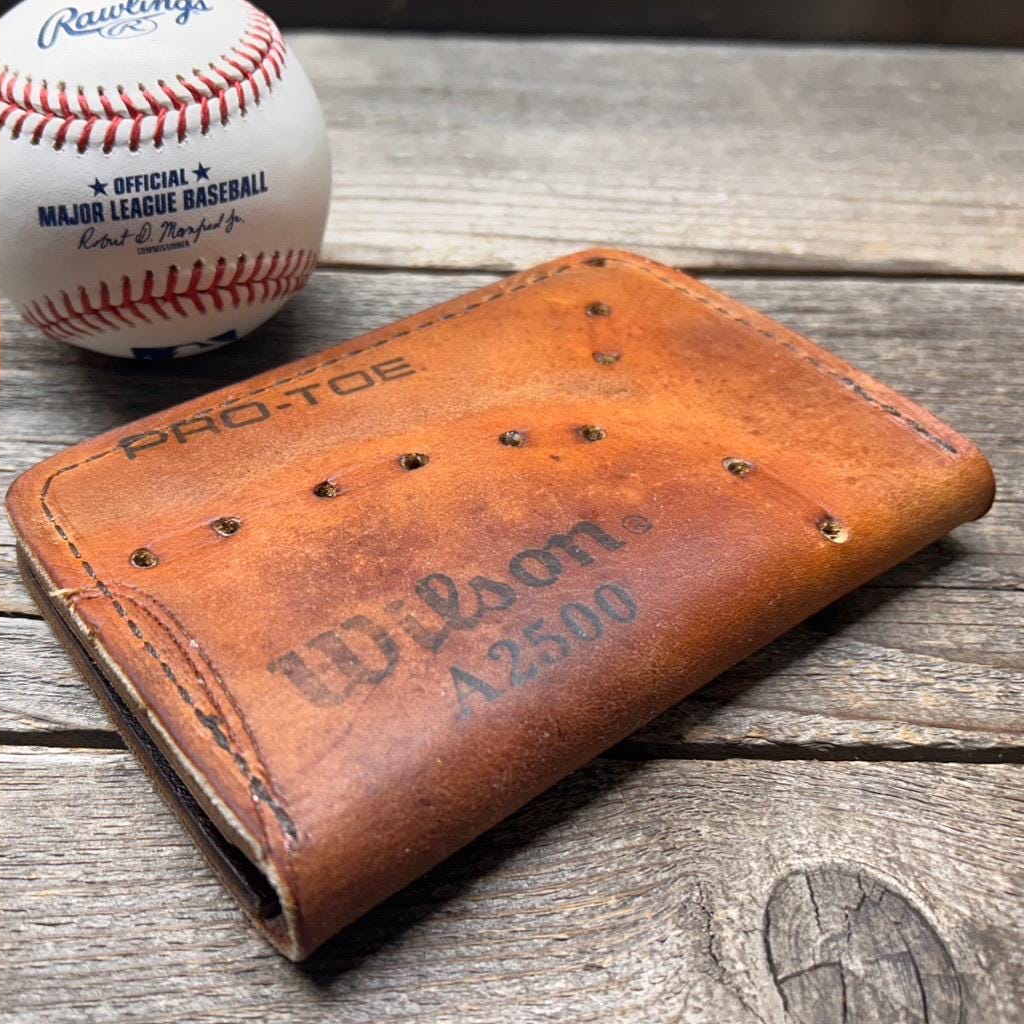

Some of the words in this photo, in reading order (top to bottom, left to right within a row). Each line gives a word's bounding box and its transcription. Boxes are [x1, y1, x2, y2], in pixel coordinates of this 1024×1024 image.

[38, 201, 105, 227] MAJOR
[110, 189, 177, 221] LEAGUE
[183, 171, 268, 211] BASEBALL
[113, 168, 189, 195] OFFICIAL
[137, 240, 190, 256] COMMISSIONER
[118, 356, 416, 460] PRO-TOE
[267, 520, 626, 709] Wilson
[452, 582, 638, 721] A2500
